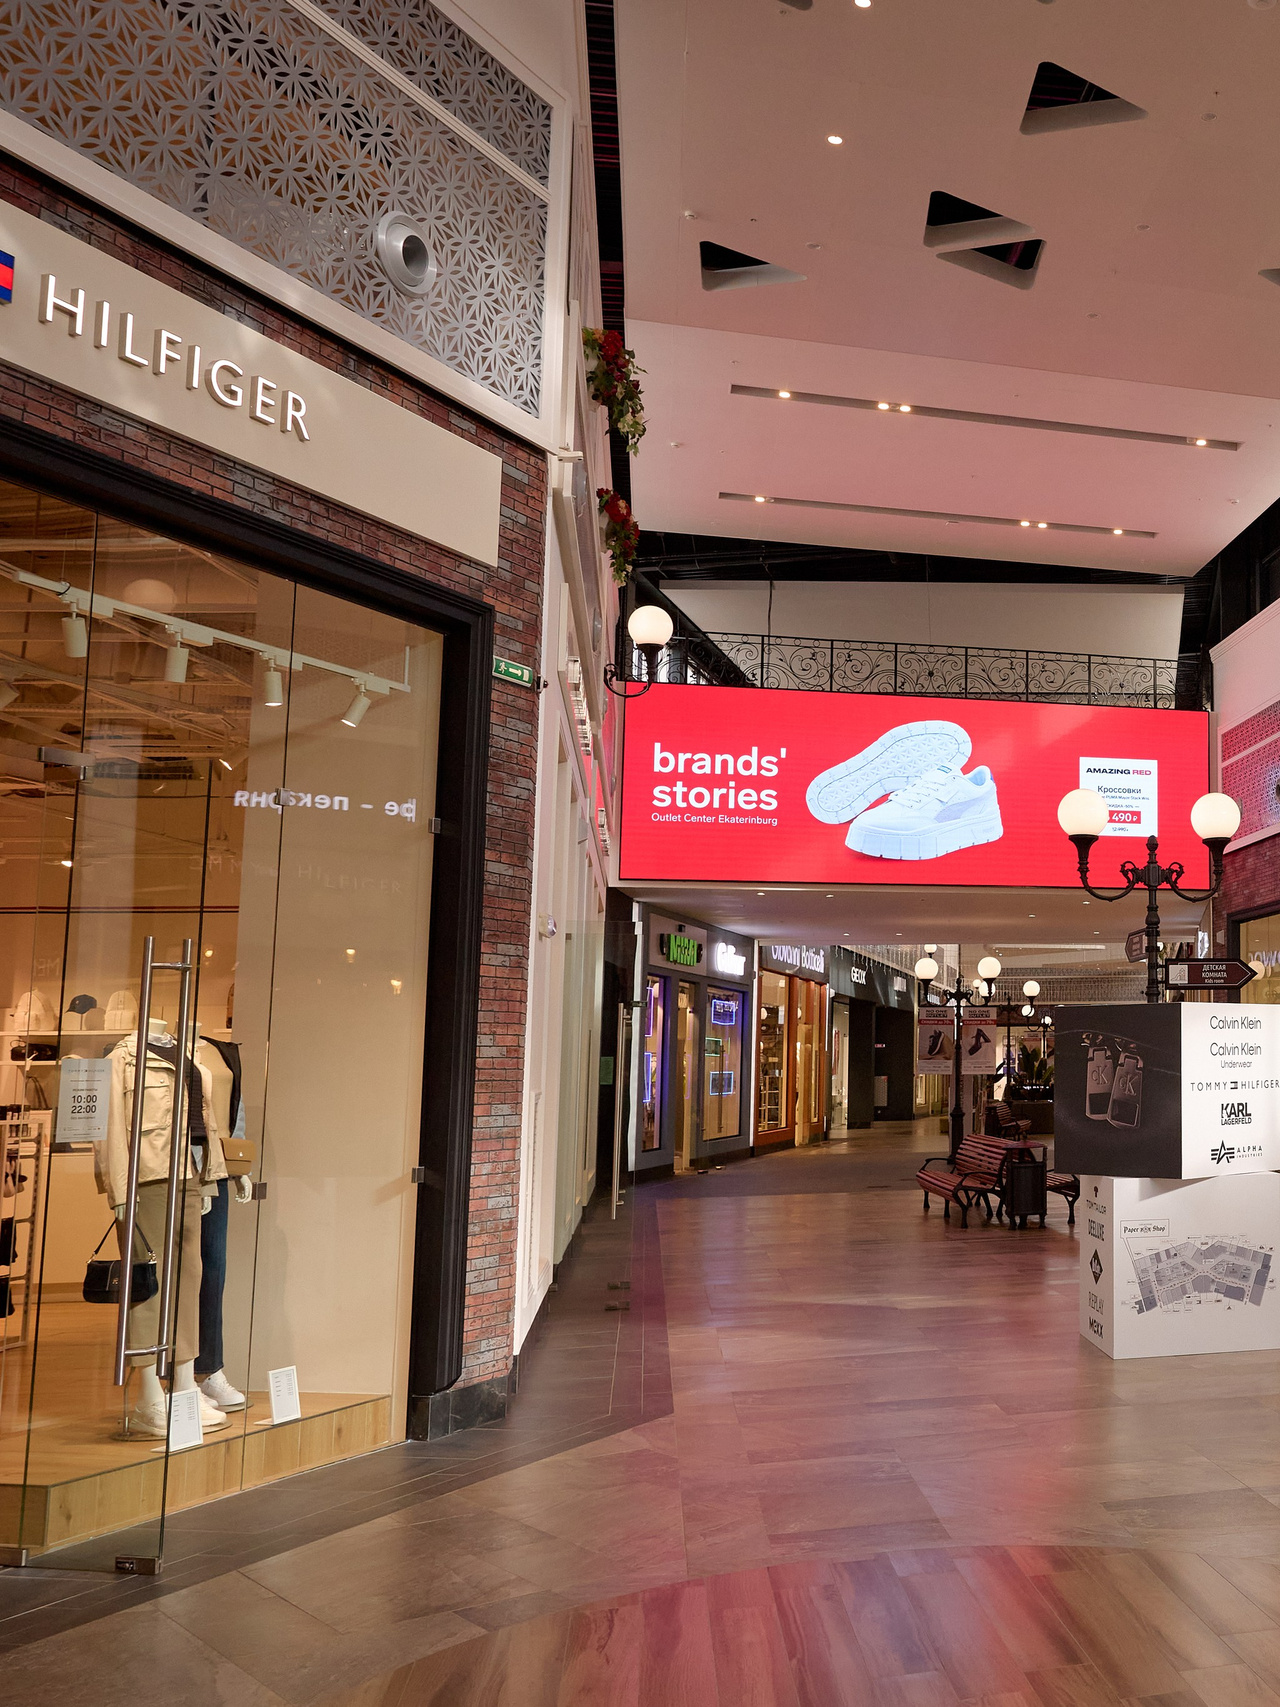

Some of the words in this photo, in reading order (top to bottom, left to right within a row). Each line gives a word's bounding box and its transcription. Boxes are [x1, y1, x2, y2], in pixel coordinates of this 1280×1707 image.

[39, 272, 311, 441] HILFIGER
[652, 742, 787, 778] brands'
[652, 780, 778, 811] stories
[1097, 785, 1142, 794] Кроссовки
[651, 812, 682, 825] Outlet
[684, 814, 715, 825] Center
[717, 815, 778, 827] Ekaterinburg
[1111, 812, 1132, 822] 490
[851, 966, 867, 985] GEOX
[1209, 1015, 1239, 1029] Calvin
[1240, 1016, 1262, 1029] Klein
[1209, 1042, 1239, 1056] Calvin
[1240, 1043, 1262, 1056] Klein
[1220, 1060, 1252, 1069] Underwear
[1190, 1082, 1228, 1091] TOMMY
[1240, 1079, 1280, 1089] HILFIGER
[71, 1094, 98, 1104] 10:00
[70, 1104, 97, 1114] 22:00
[1221, 1102, 1252, 1118] KARL
[1221, 1117, 1252, 1126] LAGERFELD
[1236, 1145, 1263, 1153] ALPHA
[1123, 1226, 1139, 1234] Paper
[1088, 1291, 1104, 1315] REPLAY
